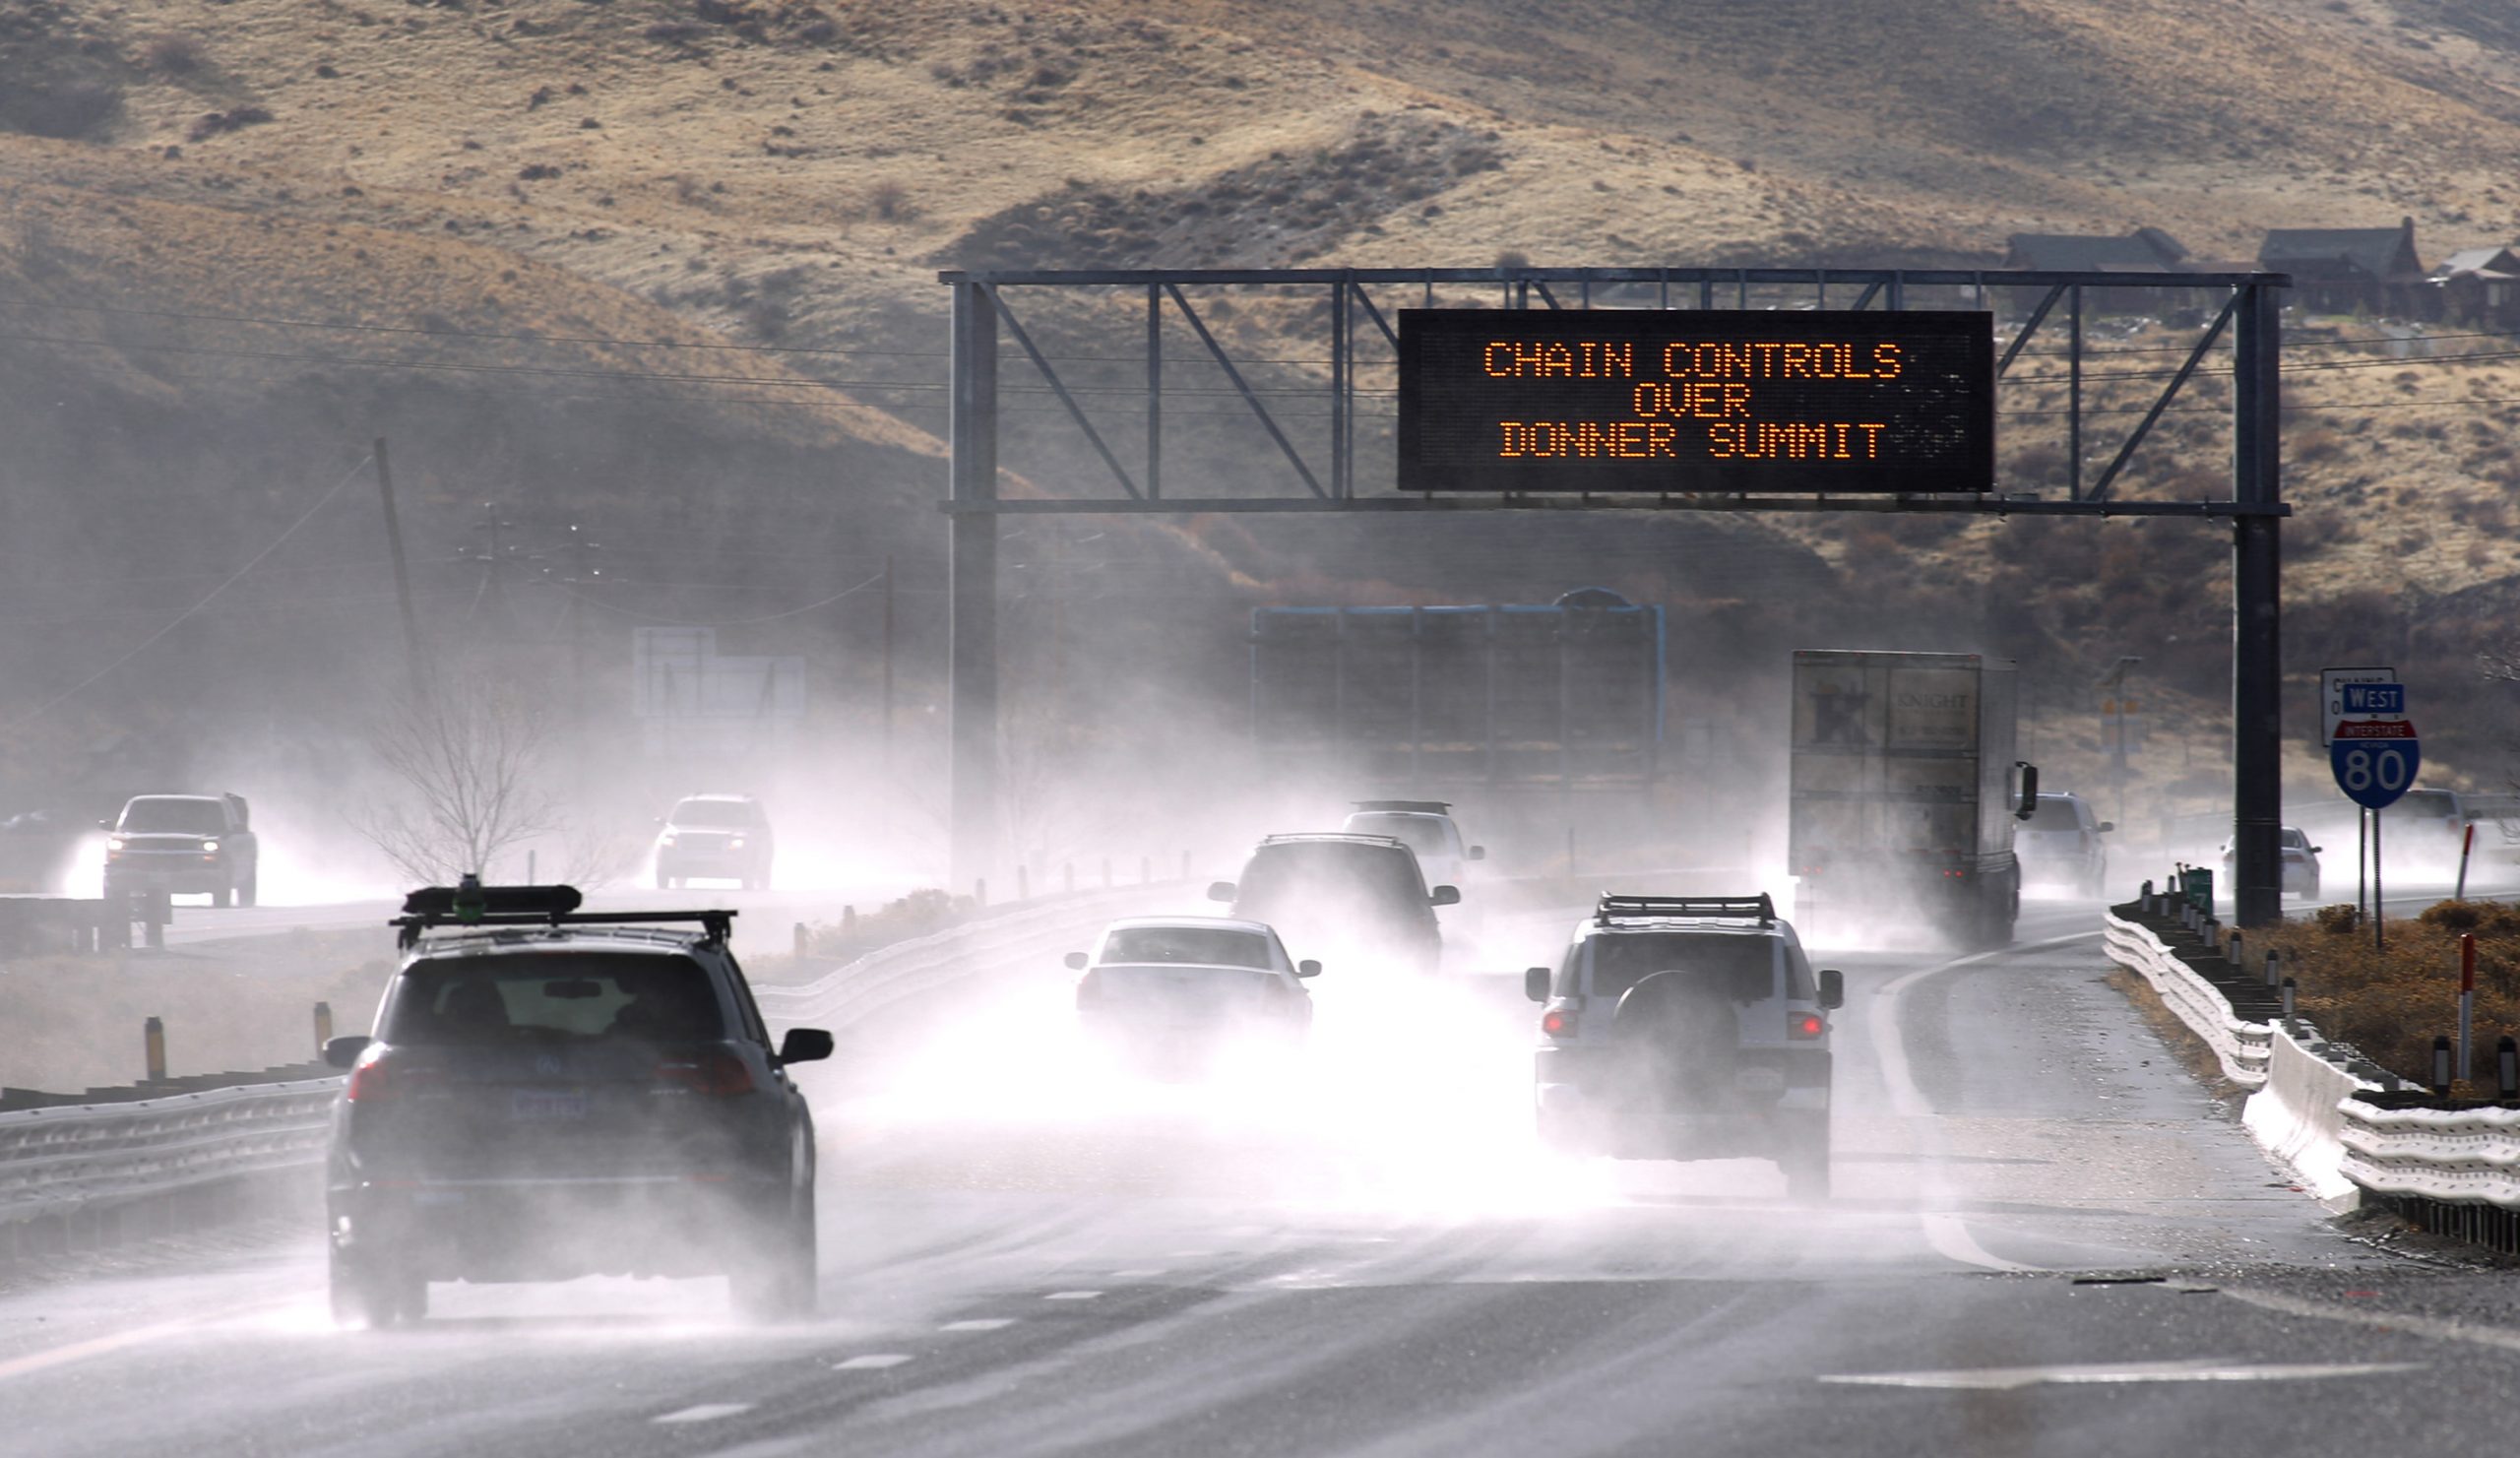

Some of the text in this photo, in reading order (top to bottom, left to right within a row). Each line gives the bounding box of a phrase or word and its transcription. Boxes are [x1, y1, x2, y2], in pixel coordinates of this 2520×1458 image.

[1483, 342, 1902, 378] CHAIN CONTROLS
[1633, 382, 1751, 417] OVER
[1498, 421, 1885, 459] DONNER SUMMIT
[1897, 692, 1969, 709] KNIGHT
[2349, 687, 2399, 708] WEST
[2344, 725, 2406, 737] INTERSTATE
[2345, 749, 2407, 792] 80
